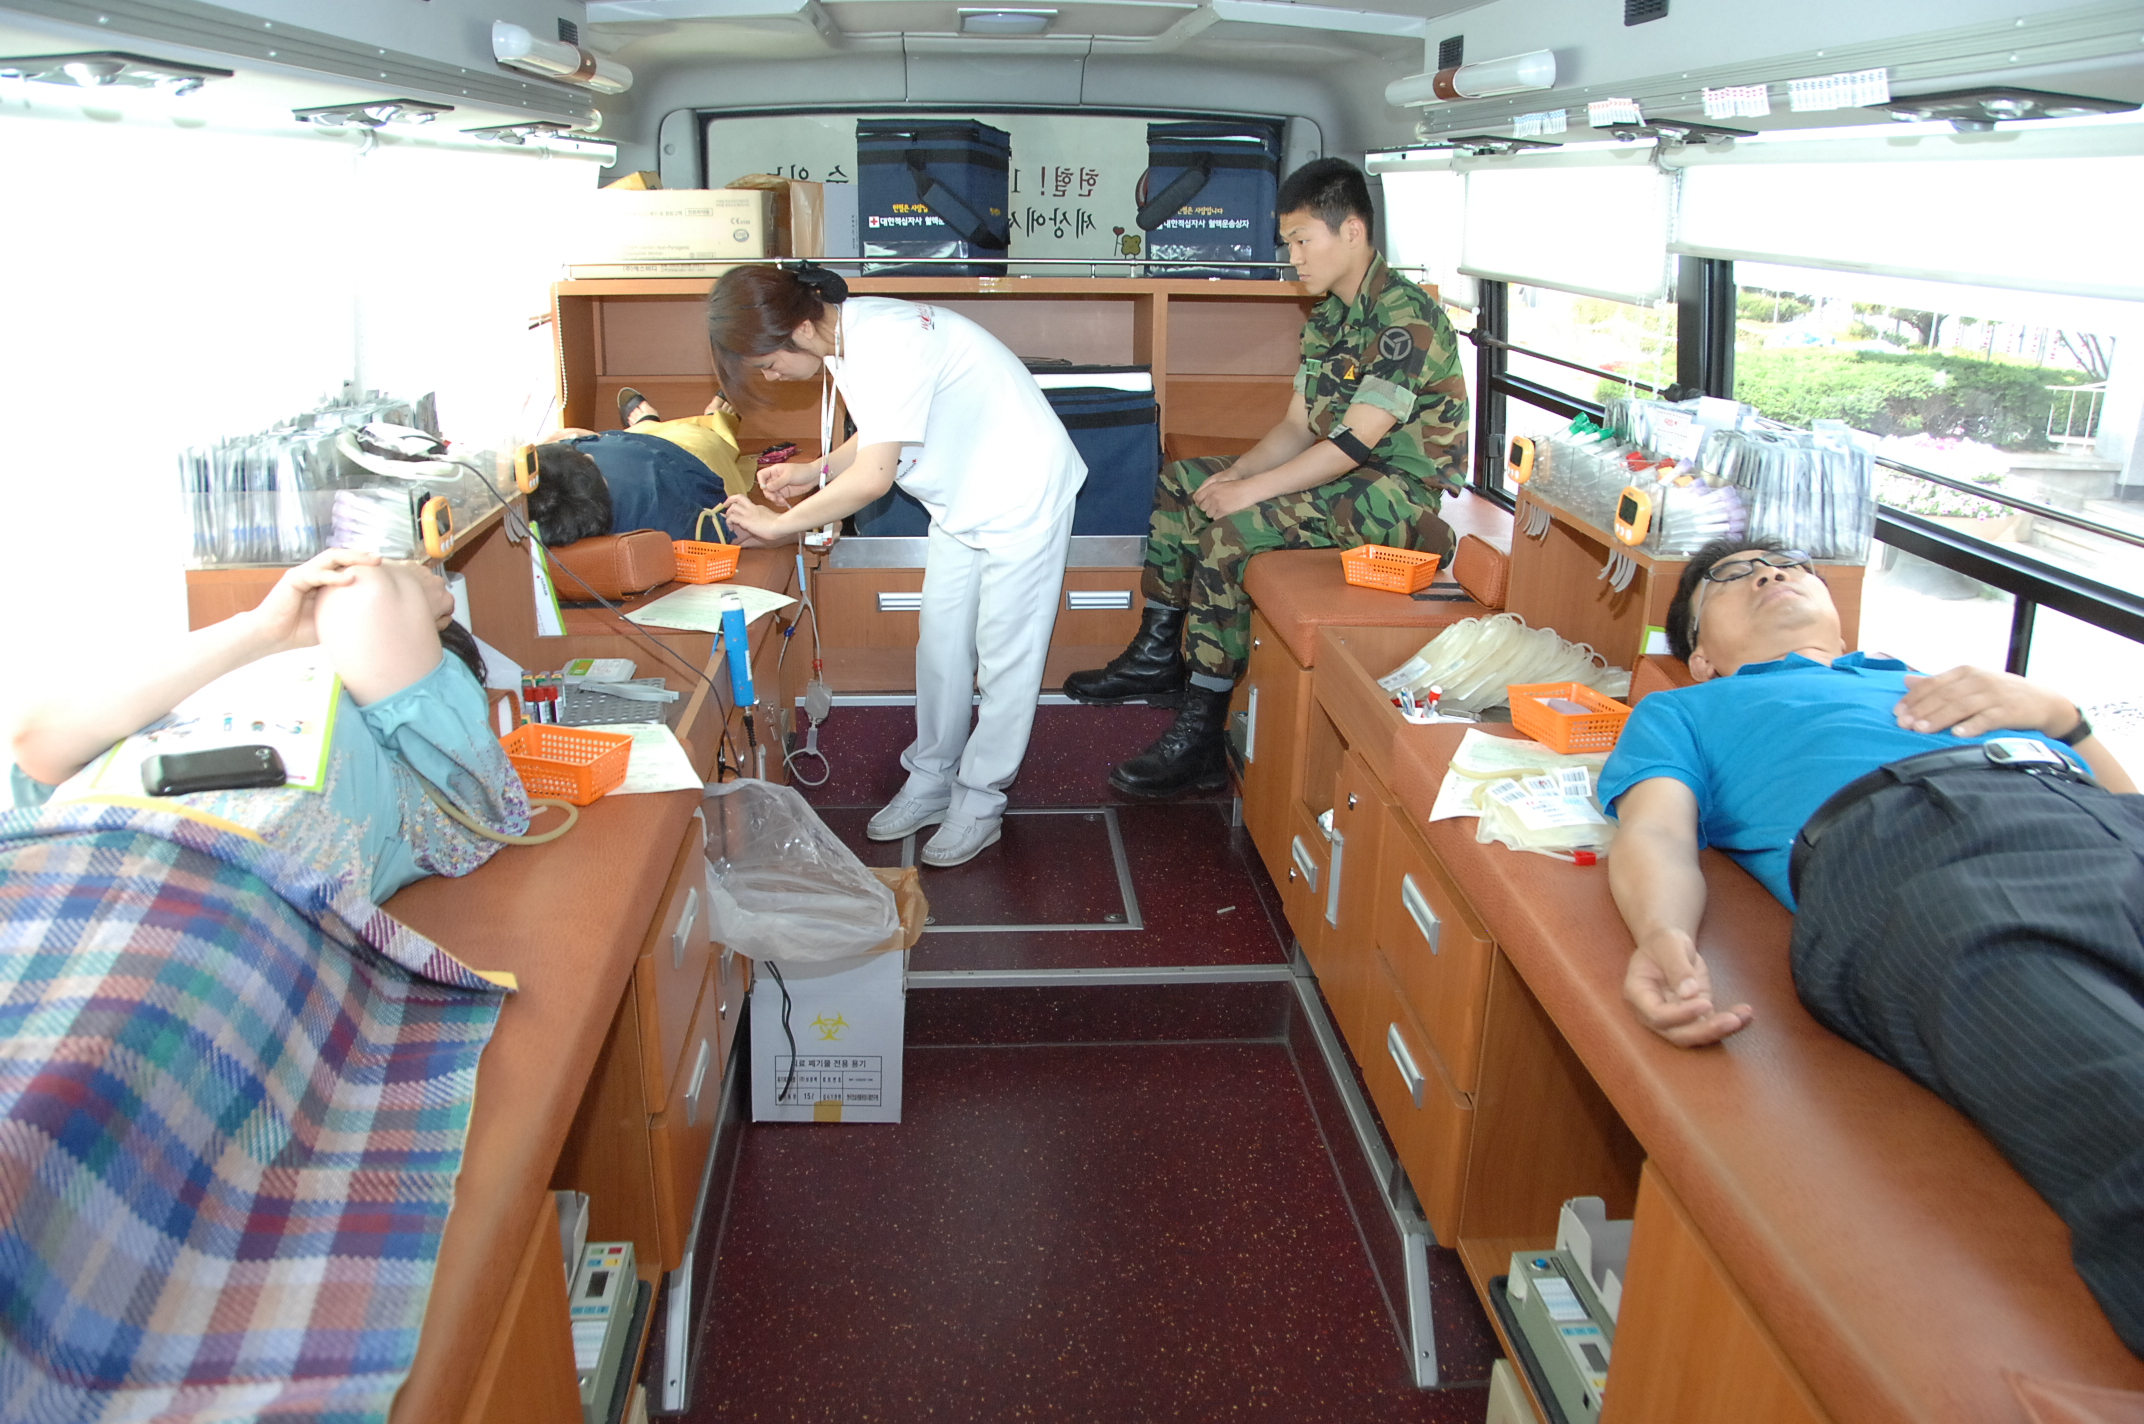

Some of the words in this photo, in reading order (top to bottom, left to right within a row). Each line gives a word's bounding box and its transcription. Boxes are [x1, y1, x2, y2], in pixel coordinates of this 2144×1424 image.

[893, 204, 910, 213] 헌혈은
[1195, 206, 1223, 215] 사랑입니다
[880, 216, 923, 226] 대한적십자사
[1208, 219, 1249, 229] 혈액운송상자
[808, 1059, 831, 1068] 폐기물
[834, 1059, 849, 1068] 전용
[851, 1060, 866, 1068] 용기
